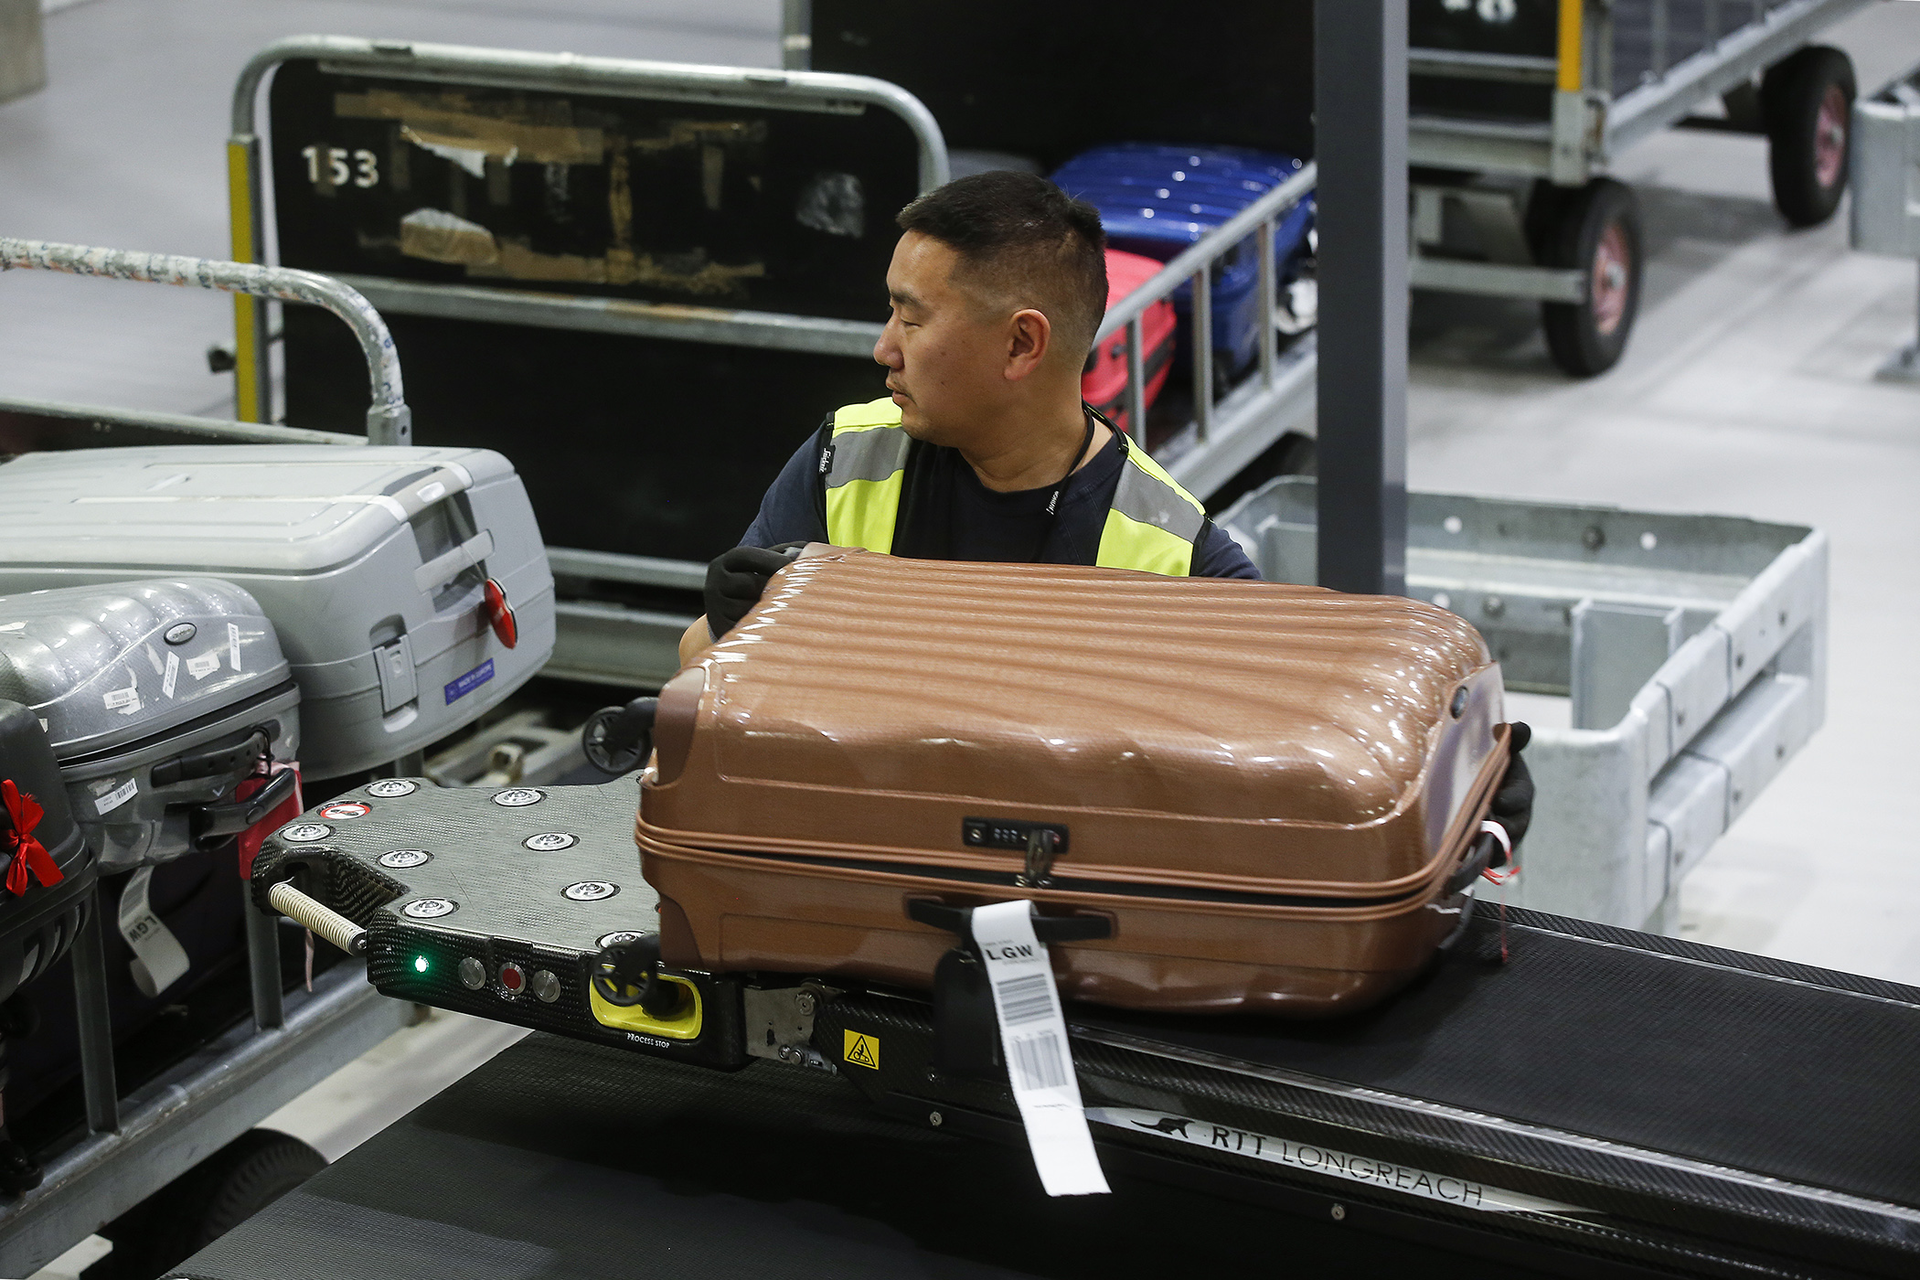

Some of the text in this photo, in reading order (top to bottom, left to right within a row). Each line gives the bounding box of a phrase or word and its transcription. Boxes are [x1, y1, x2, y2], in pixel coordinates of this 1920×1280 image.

[301, 146, 379, 188] 153
[129, 915, 158, 942] LGW
[985, 944, 1034, 961] LGW
[626, 1032, 670, 1050] PROCESS STOP
[1211, 1125, 1483, 1206] RTT LONGREACH
